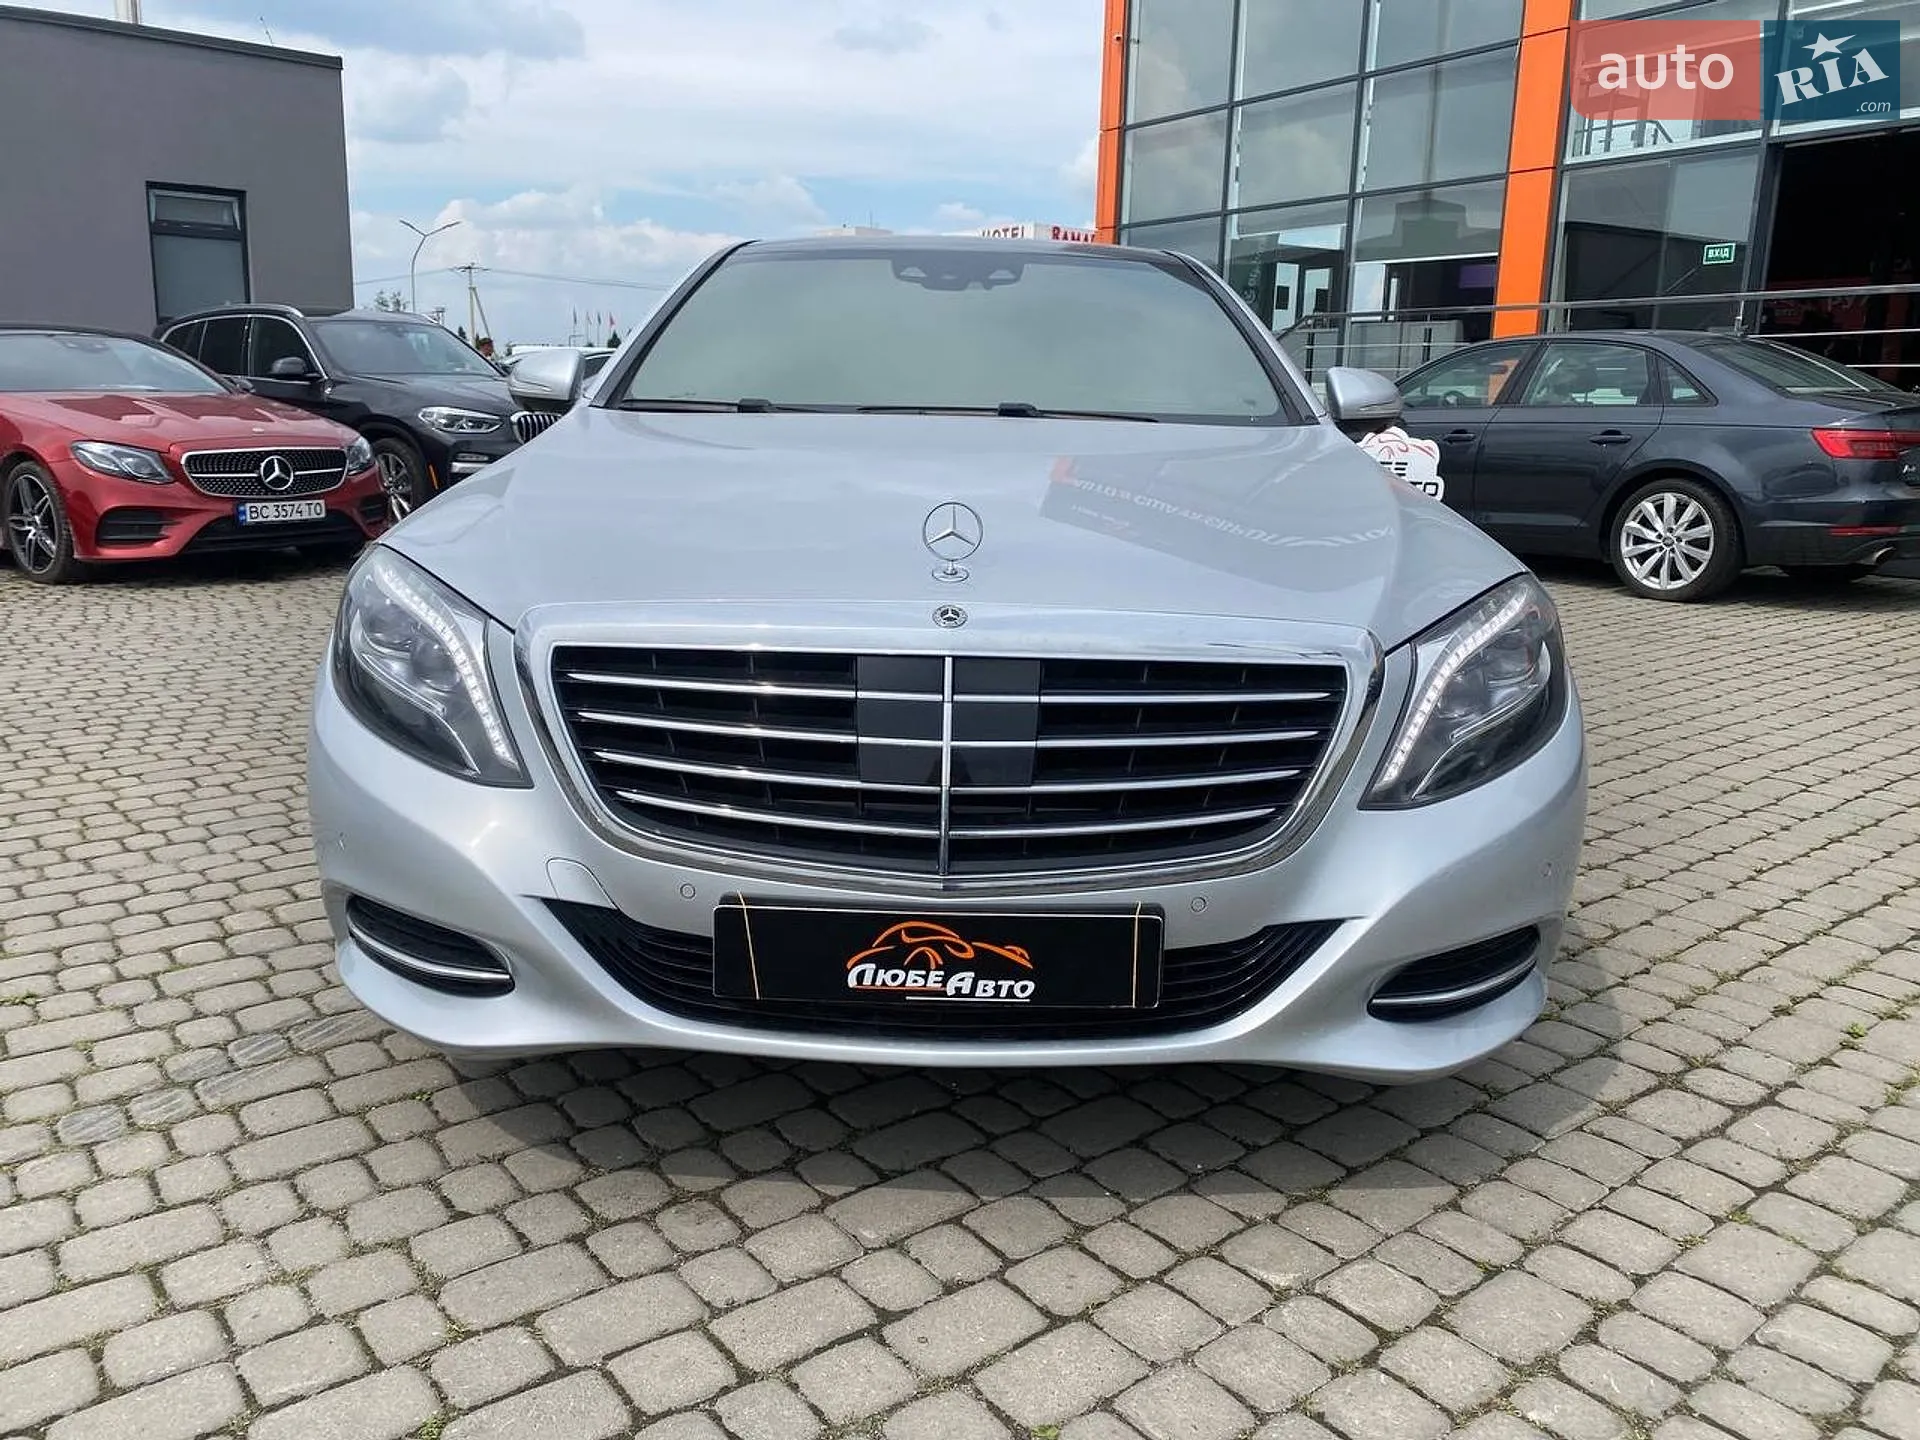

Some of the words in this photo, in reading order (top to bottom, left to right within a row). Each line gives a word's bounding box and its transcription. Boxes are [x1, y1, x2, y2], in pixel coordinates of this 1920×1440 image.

[249, 505, 270, 520] BC
[273, 503, 303, 519] 3574
[305, 502, 323, 516] TO
